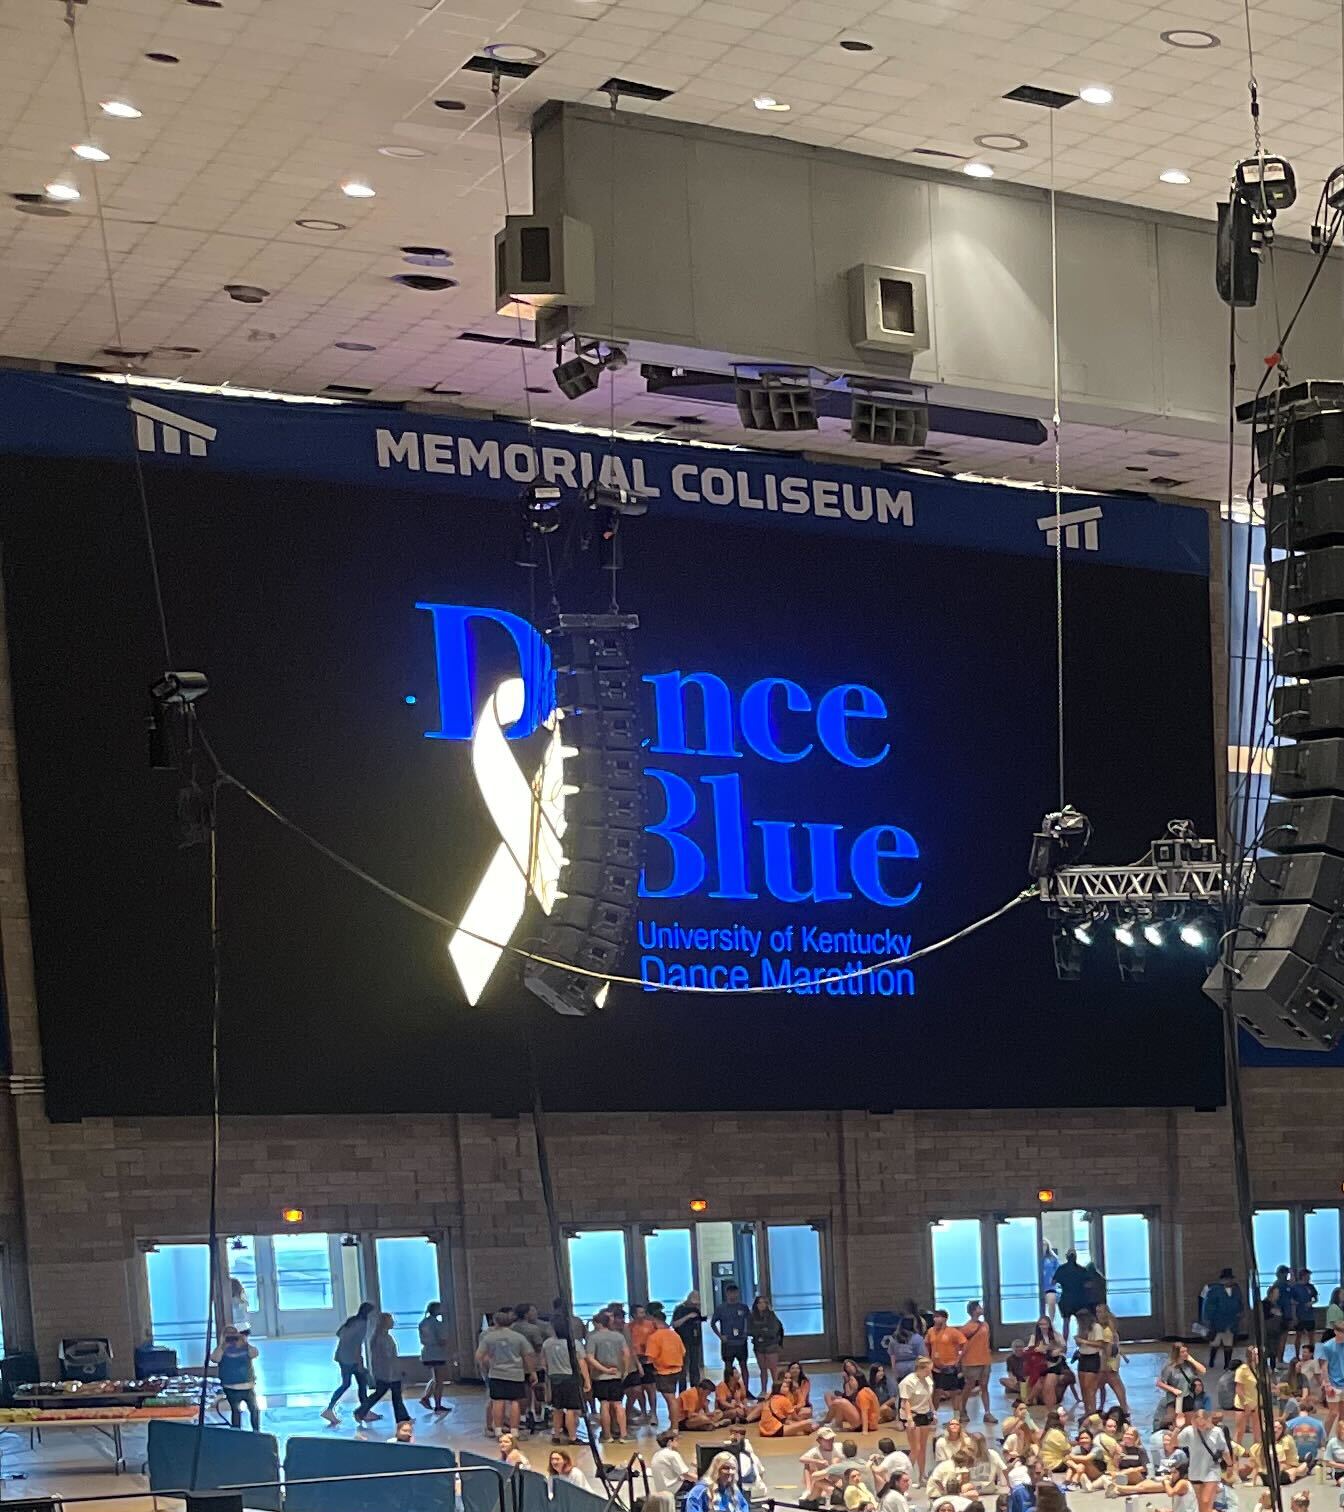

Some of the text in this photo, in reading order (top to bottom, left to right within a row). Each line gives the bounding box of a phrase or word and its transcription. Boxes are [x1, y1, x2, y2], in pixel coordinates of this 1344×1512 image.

[376, 428, 914, 527] MEMORIAL COLISEUM
[415, 602, 892, 768] Dnce
[636, 920, 912, 962] University of Kentucky
[640, 954, 916, 997] Dance Marathon
